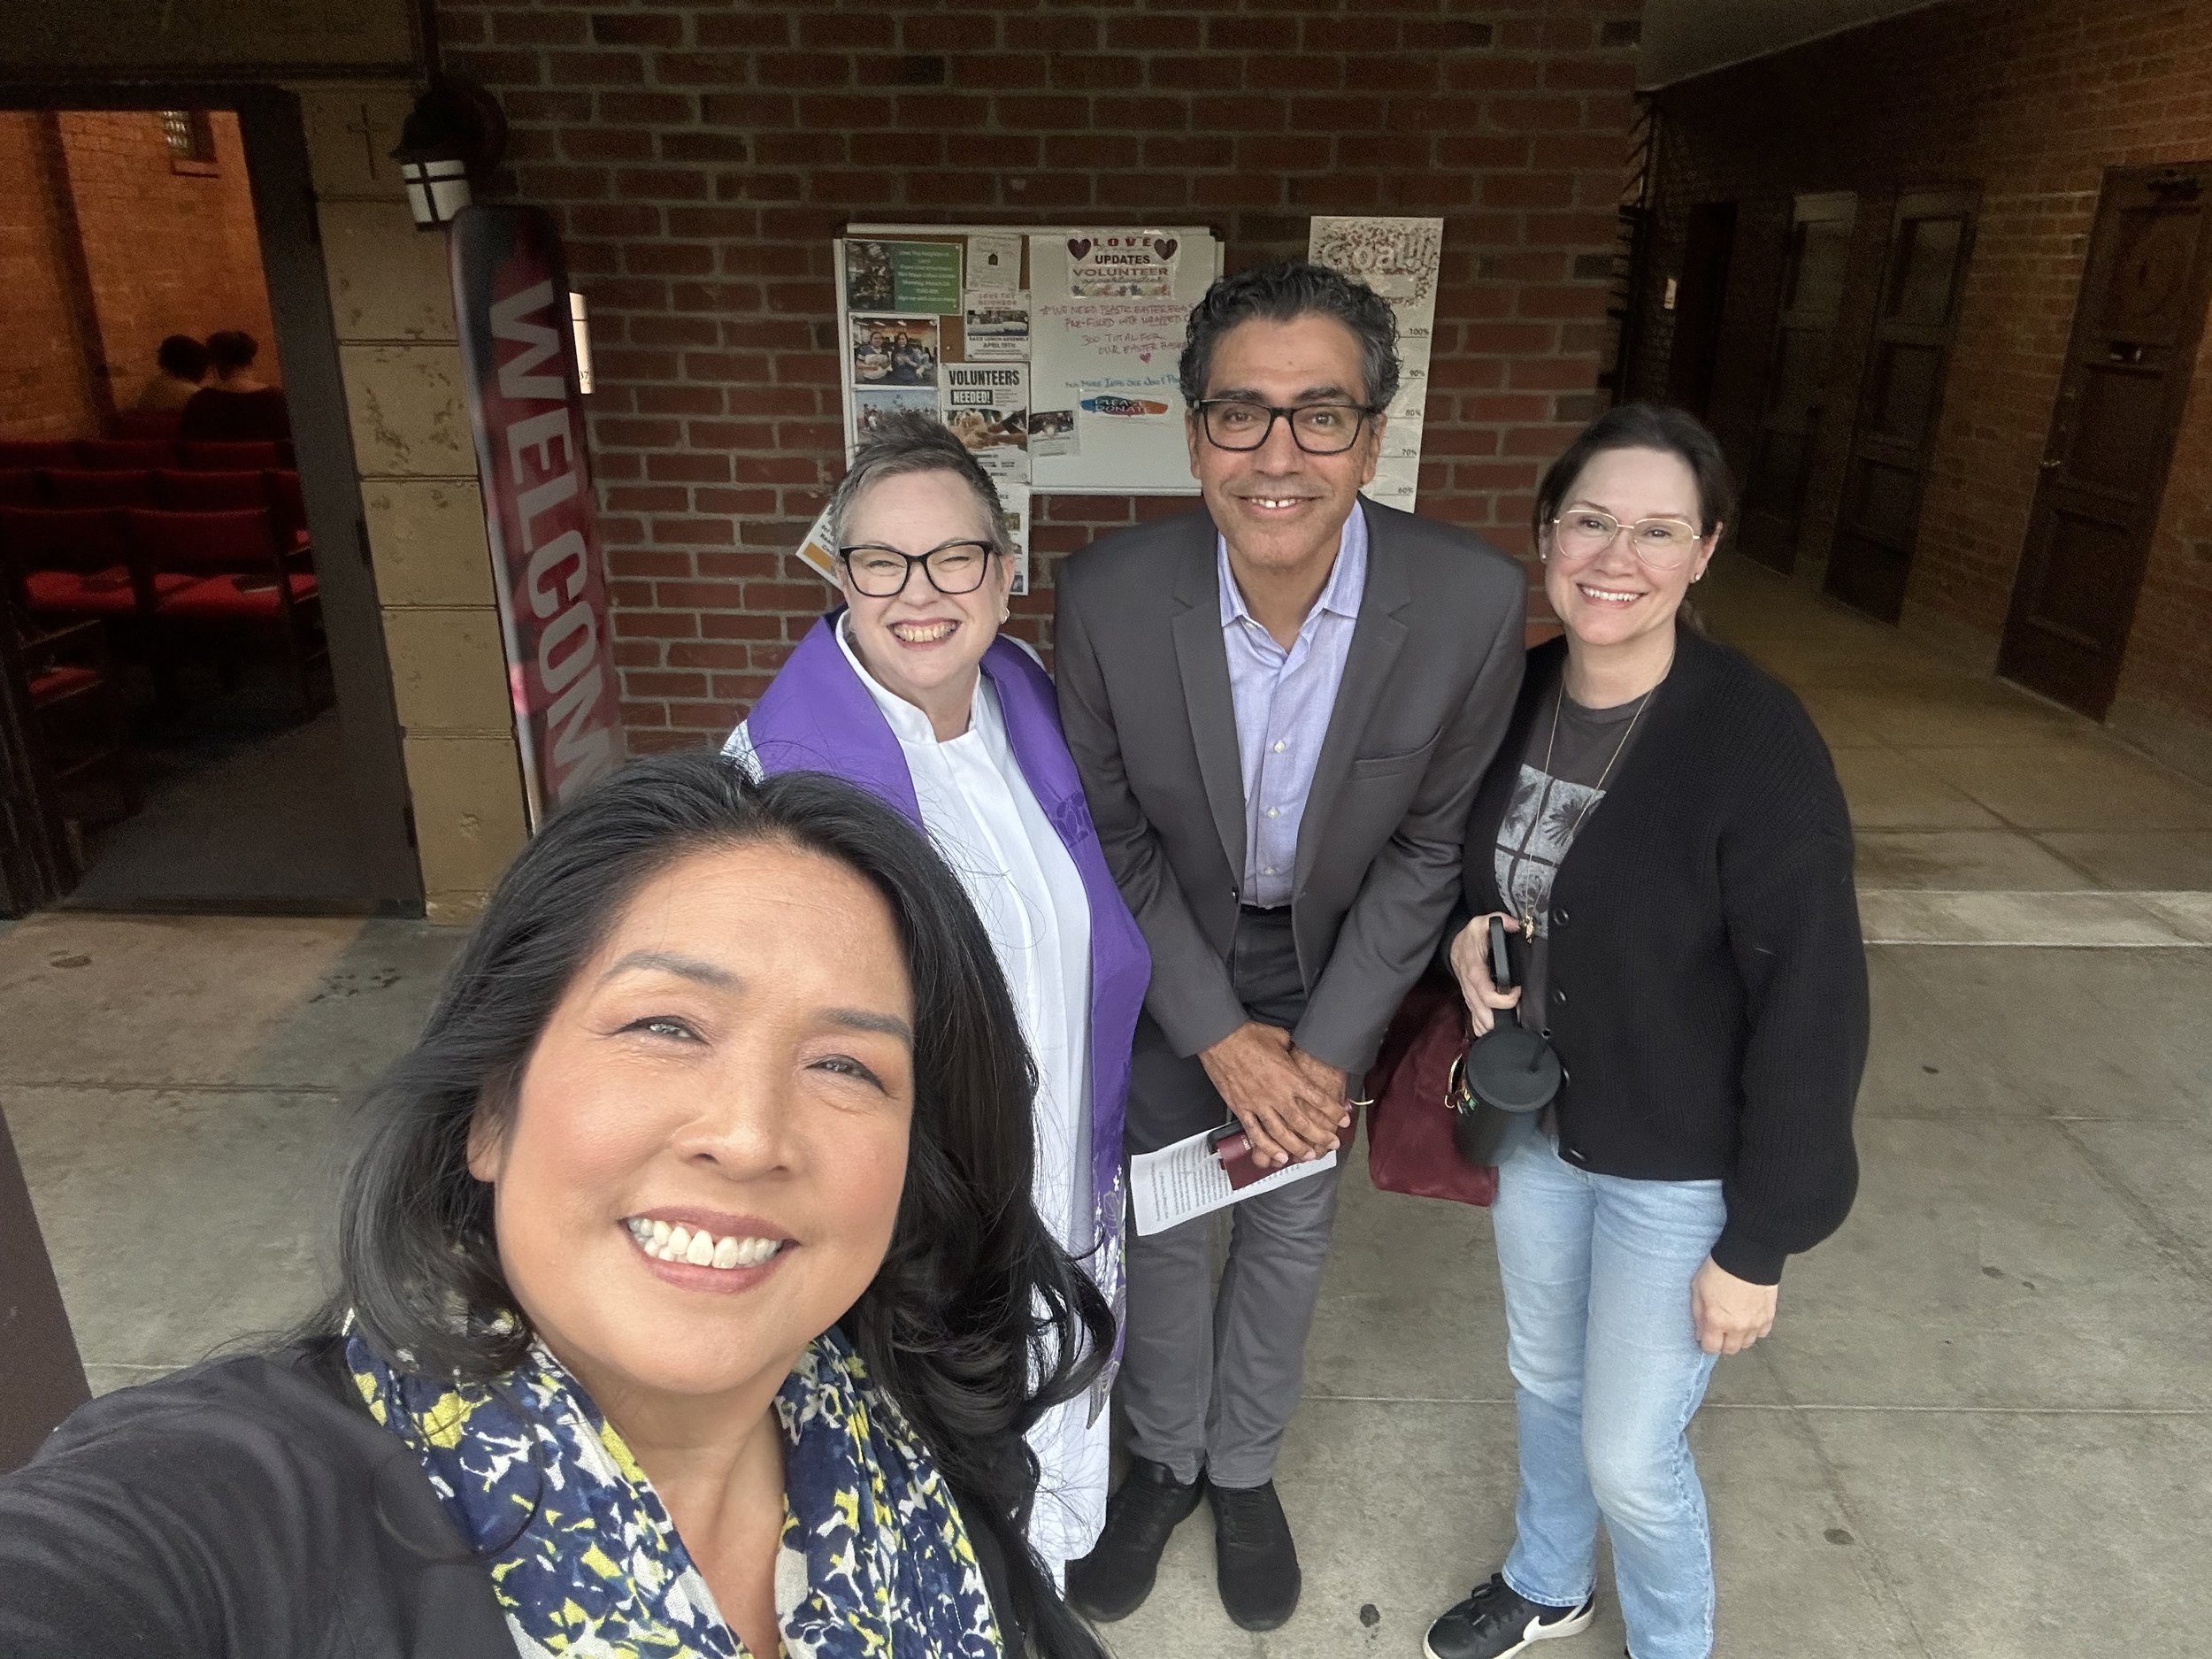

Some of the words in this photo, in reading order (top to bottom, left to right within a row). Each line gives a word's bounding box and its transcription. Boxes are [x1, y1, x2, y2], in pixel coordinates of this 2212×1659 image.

[1093, 238, 1151, 247] LOVE
[1095, 255, 1150, 265] UPDATES
[1072, 267, 1169, 277] VOLUNTEER
[1409, 327, 1429, 336] 100%
[949, 370, 1020, 386] VOLUNTEERS
[952, 390, 991, 403] NEEDED!
[489, 280, 613, 803] WELCOM
